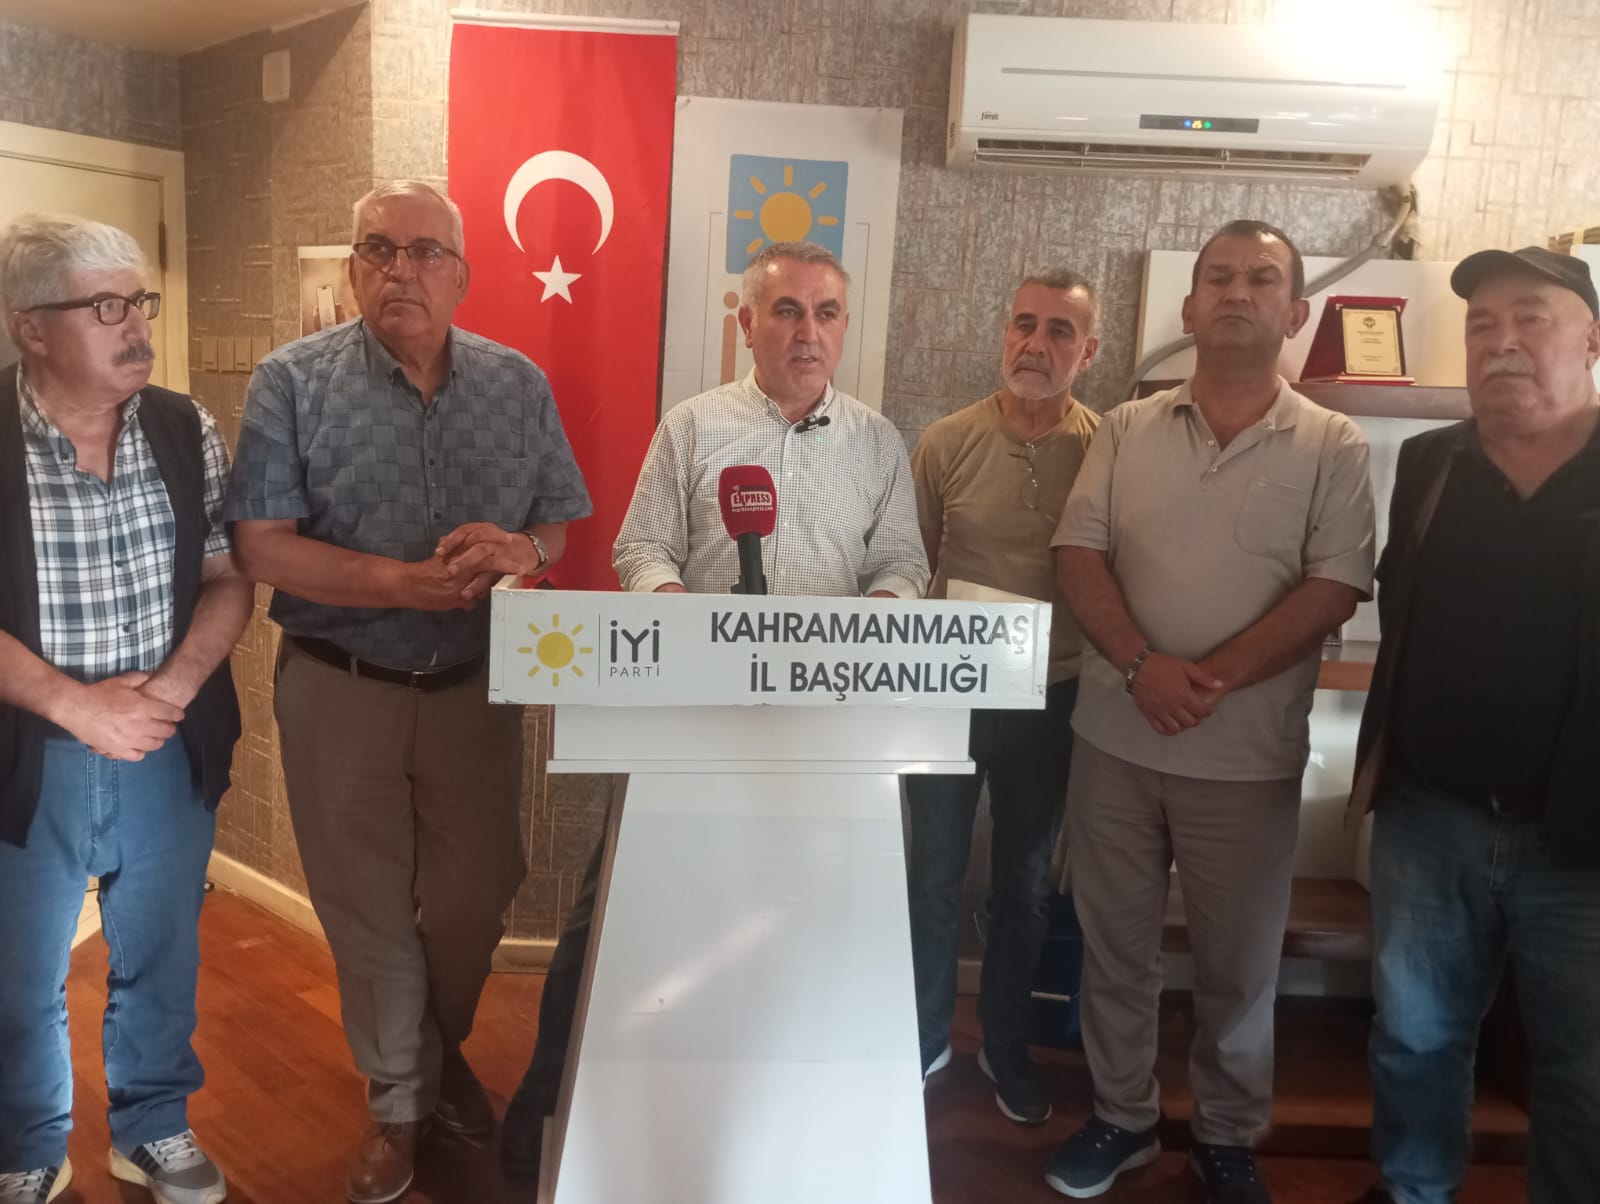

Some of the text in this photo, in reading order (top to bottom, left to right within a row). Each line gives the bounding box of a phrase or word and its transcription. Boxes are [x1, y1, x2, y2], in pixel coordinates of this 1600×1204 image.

[733, 493, 771, 507] EXPRESS
[610, 620, 660, 663] İYİ
[711, 611, 1030, 654] KAHRAMANMARAŞ
[751, 653, 988, 702] İL BAŞKANLIĞI
